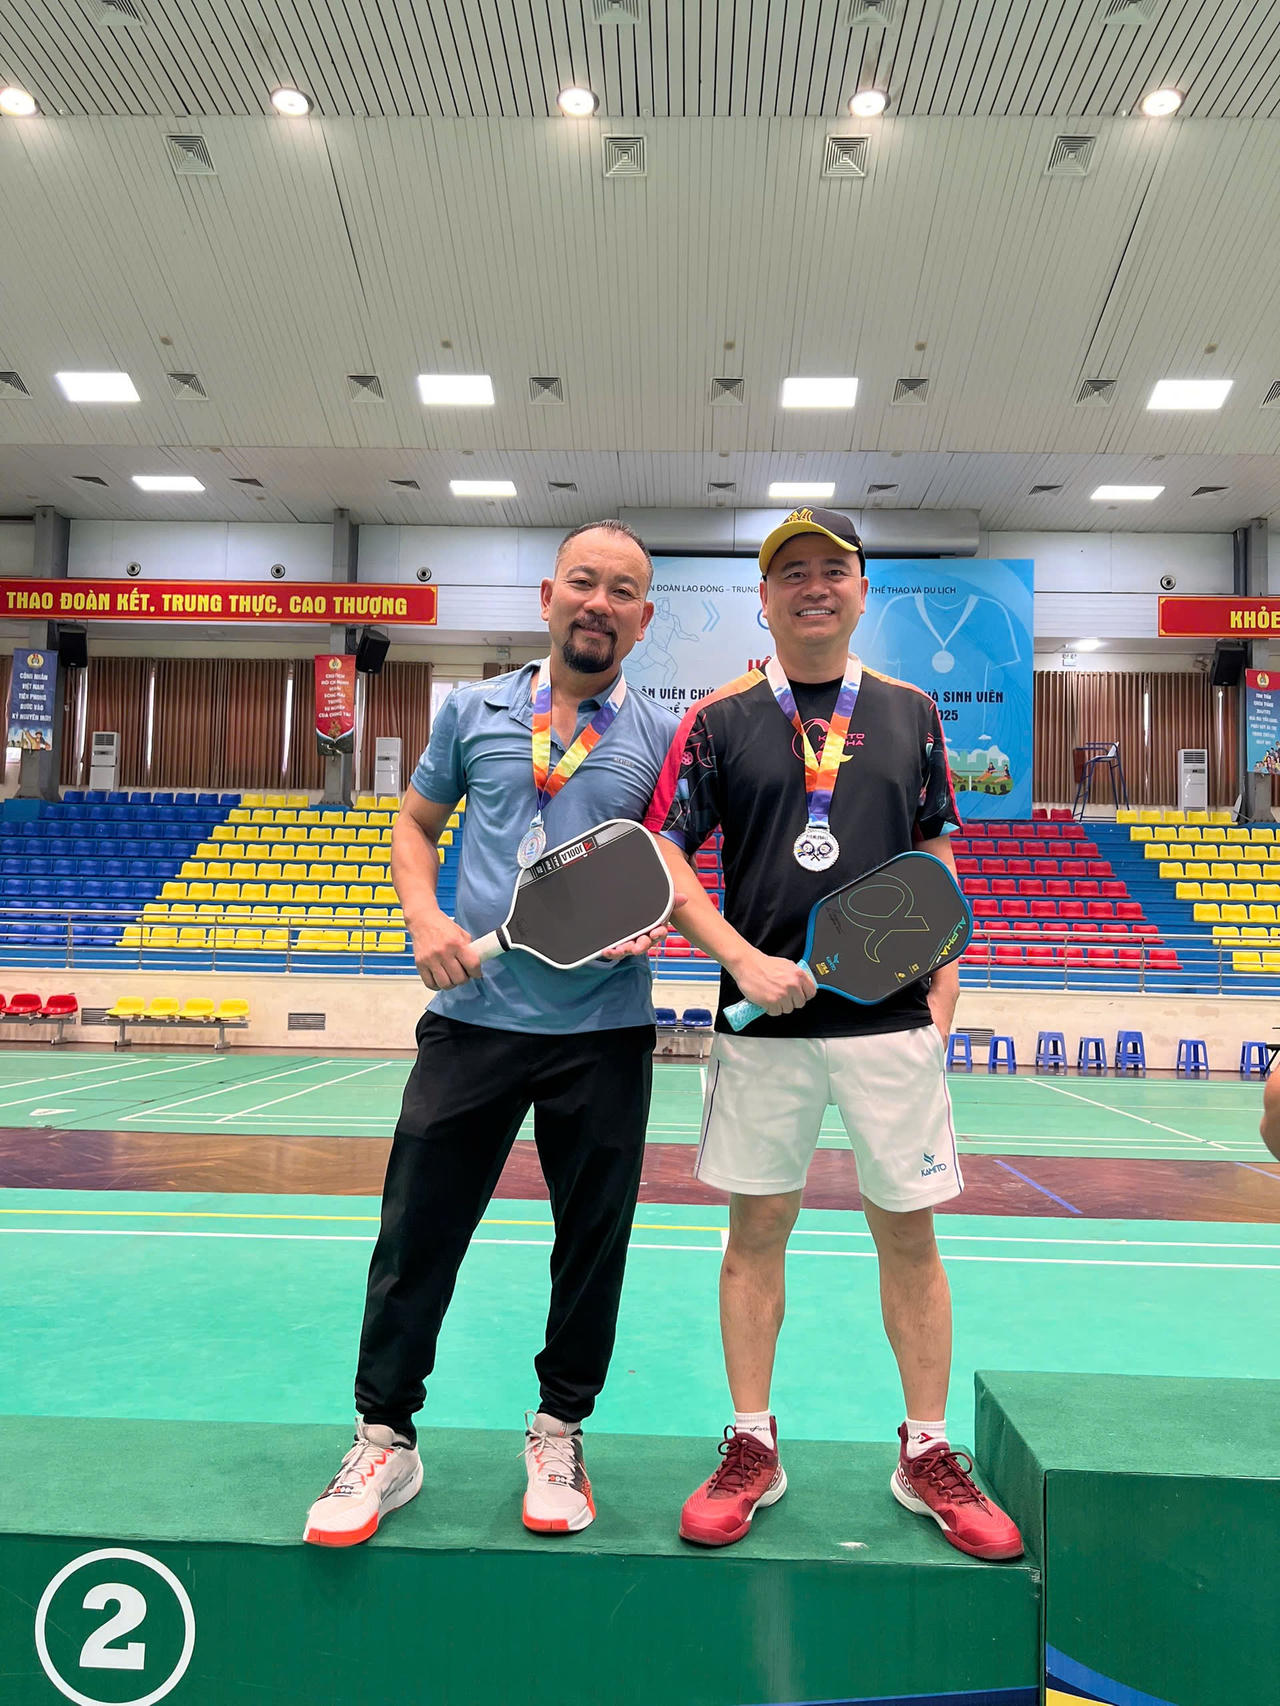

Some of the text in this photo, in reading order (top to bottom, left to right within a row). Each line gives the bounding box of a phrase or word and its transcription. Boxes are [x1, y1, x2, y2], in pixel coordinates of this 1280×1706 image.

[656, 583, 681, 592] ĐOÀN
[732, 585, 759, 593] TRUNG
[886, 587, 910, 595] THAO
[910, 585, 922, 594] VÀ
[6, 587, 408, 618] THAO ĐOÀN KẾT, TRUNG THỰC, CAO THƯỢNG
[1230, 605, 1280, 629] KHỎE
[660, 686, 686, 700] VIÊN
[943, 691, 972, 703] SINH
[976, 688, 1004, 703] VIÊN
[561, 844, 583, 861] JOOLA
[940, 915, 967, 957] ALPHA
[79, 1582, 148, 1671] 2
